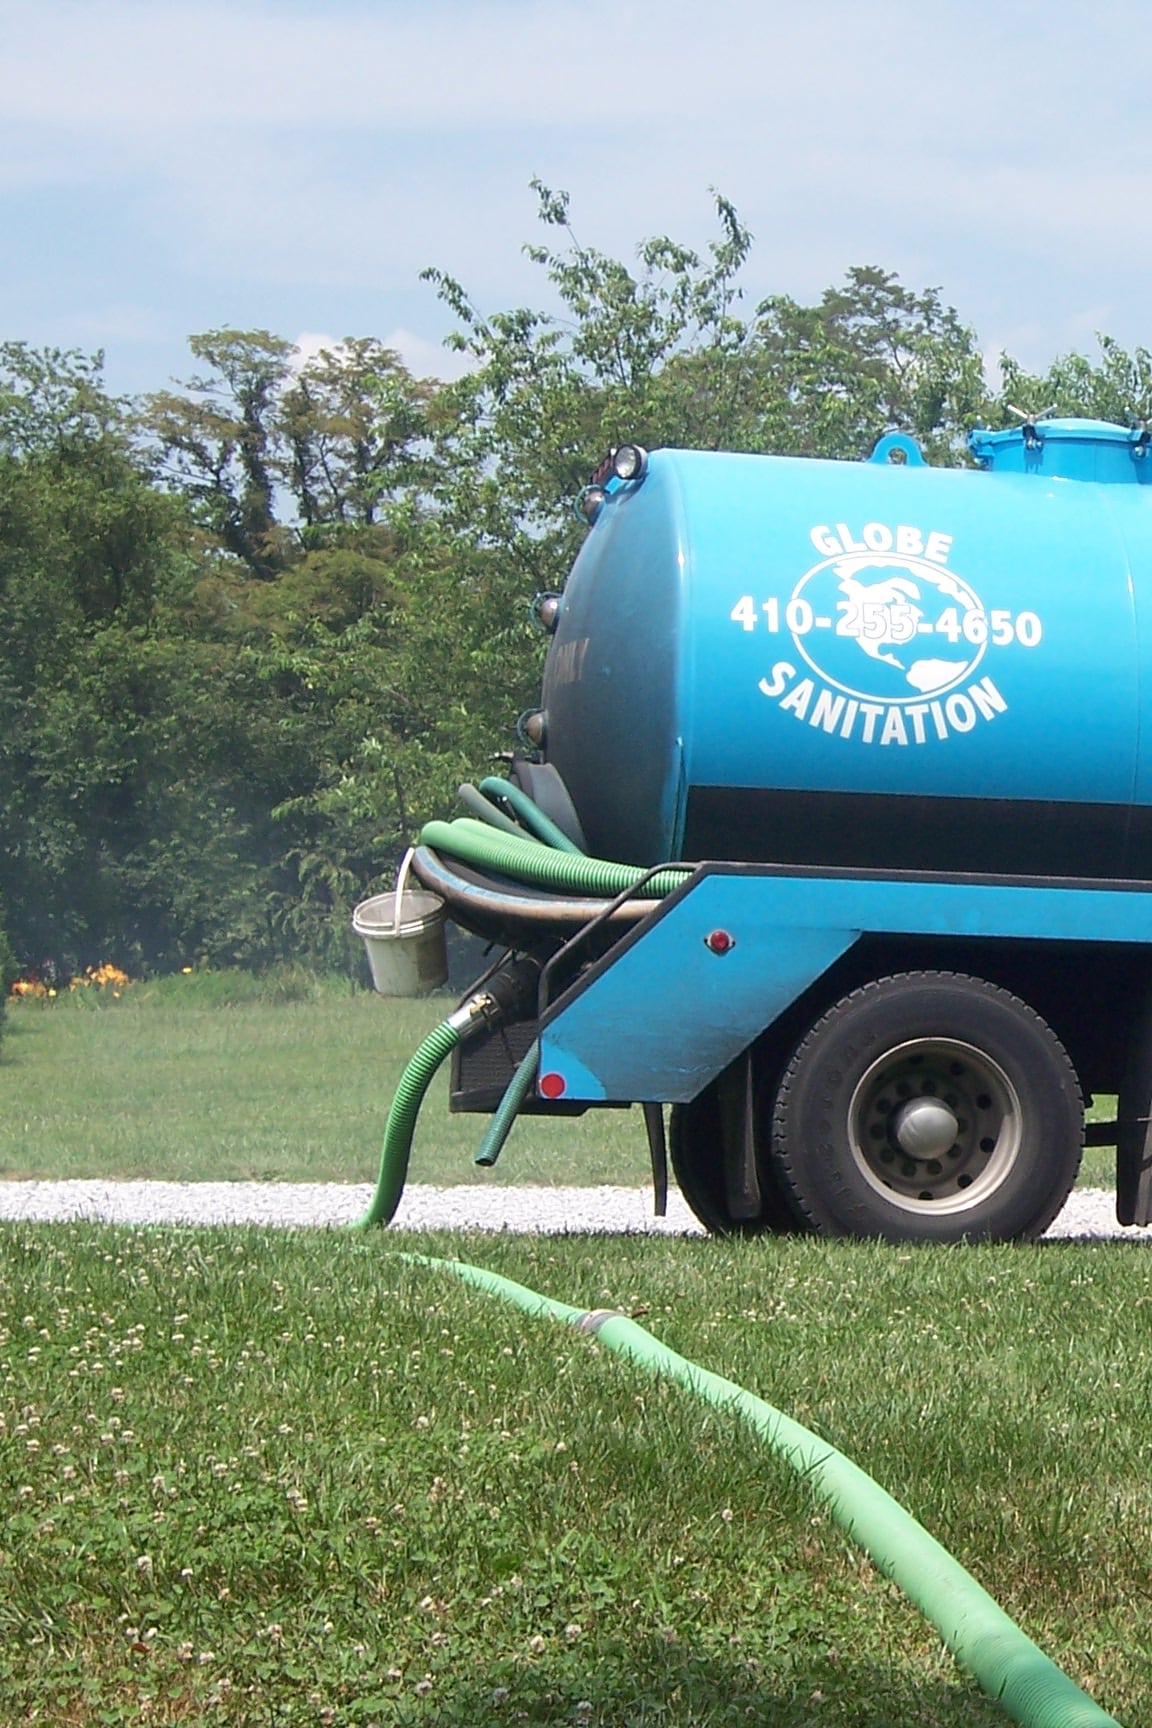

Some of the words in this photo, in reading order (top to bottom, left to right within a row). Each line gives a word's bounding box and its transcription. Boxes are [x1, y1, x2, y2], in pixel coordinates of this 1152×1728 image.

[810, 522, 954, 563] GLOBE
[731, 595, 1042, 647] 410-255-4650
[758, 661, 1008, 745] SANITATION
